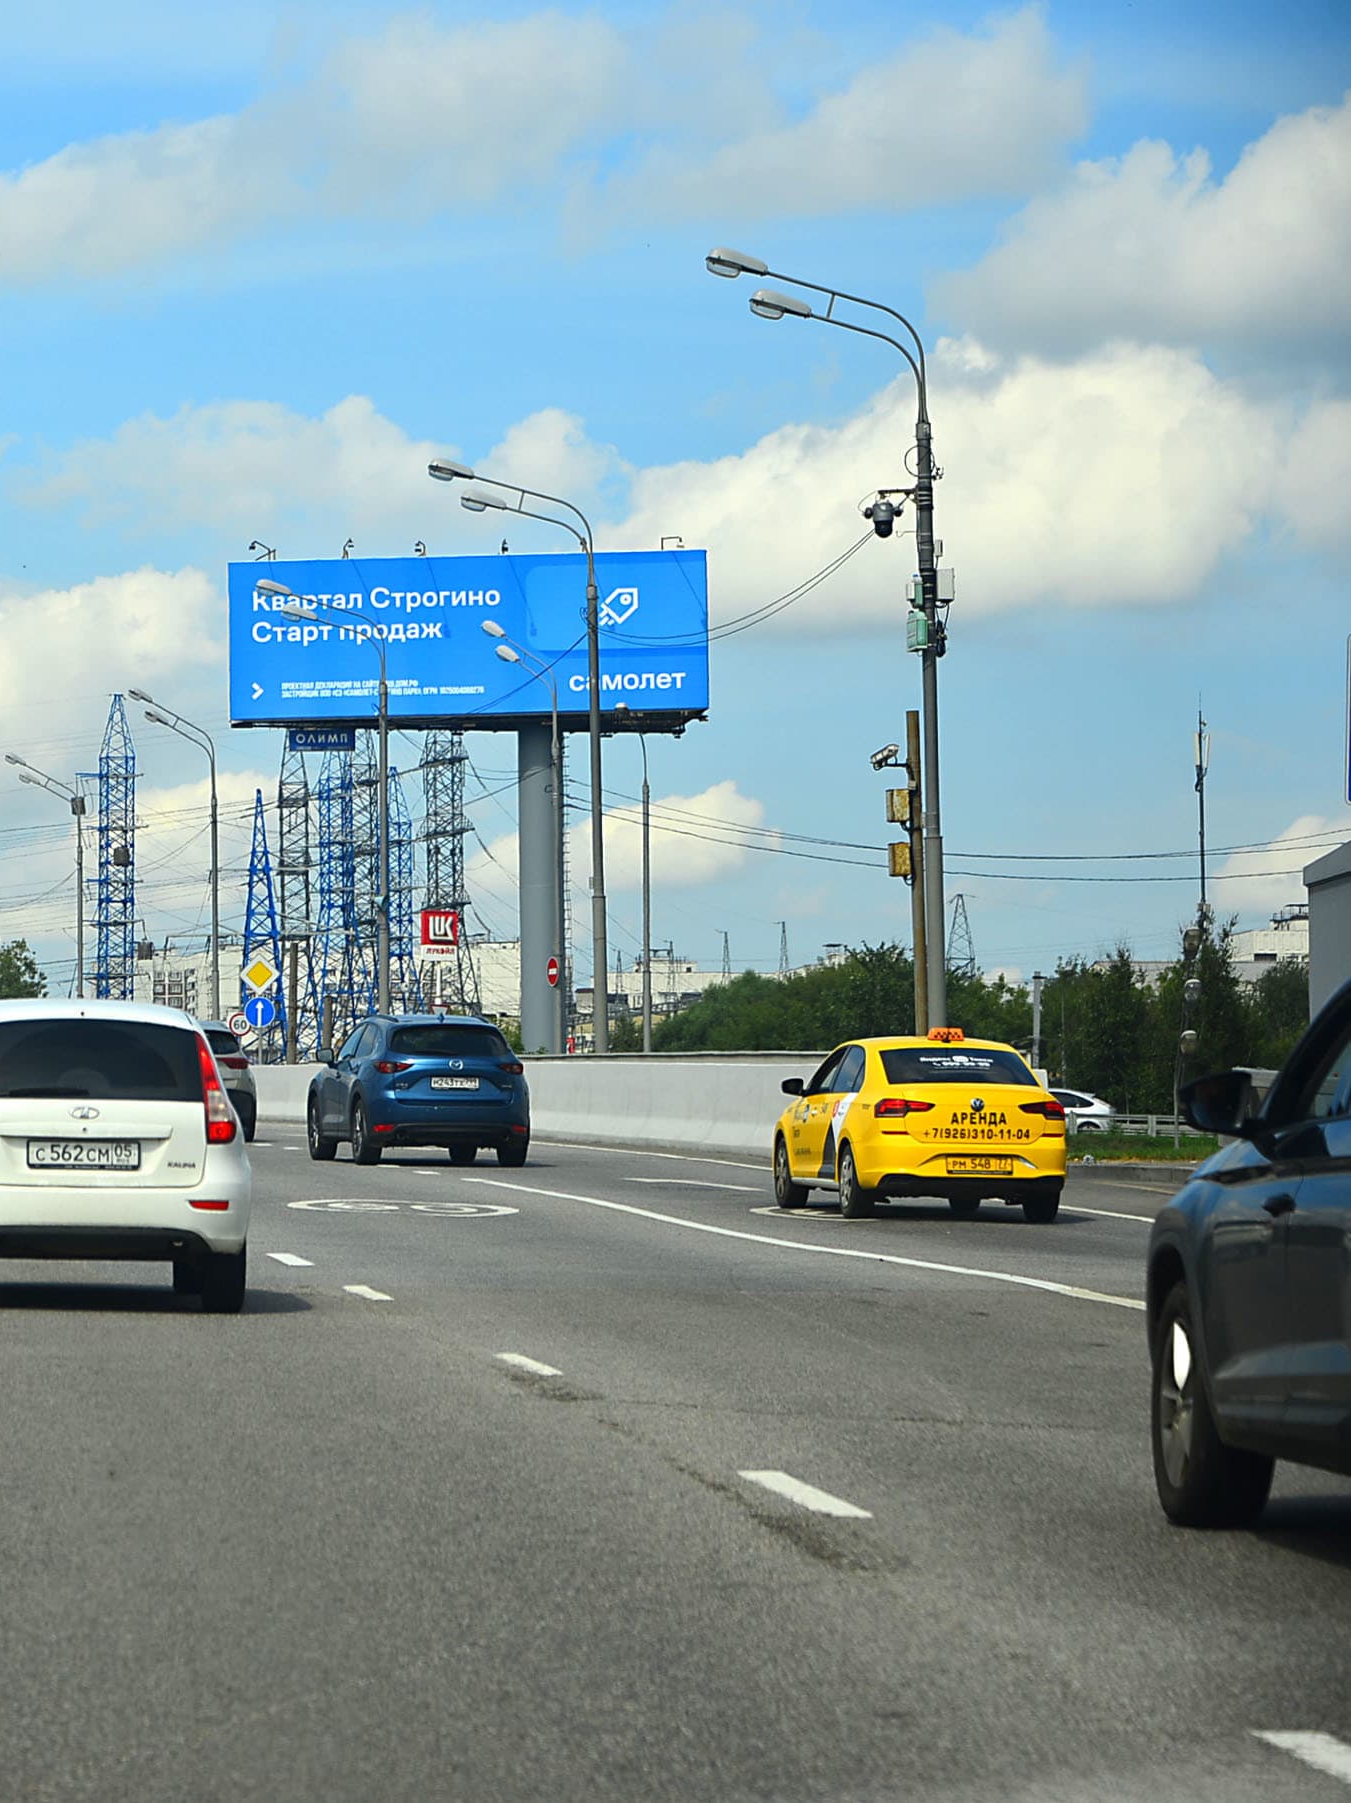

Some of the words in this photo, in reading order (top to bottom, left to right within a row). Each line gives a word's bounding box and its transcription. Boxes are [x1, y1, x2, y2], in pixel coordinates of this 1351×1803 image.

[252, 590, 363, 613] Квартал
[370, 587, 501, 613] Строгино
[252, 621, 333, 646] Старт
[339, 621, 443, 646] продаж
[295, 733, 348, 744] ОЛИМП
[233, 1019, 248, 1030] 60
[950, 1112, 1007, 1127] АРЕНДА
[114, 1143, 132, 1158] 05
